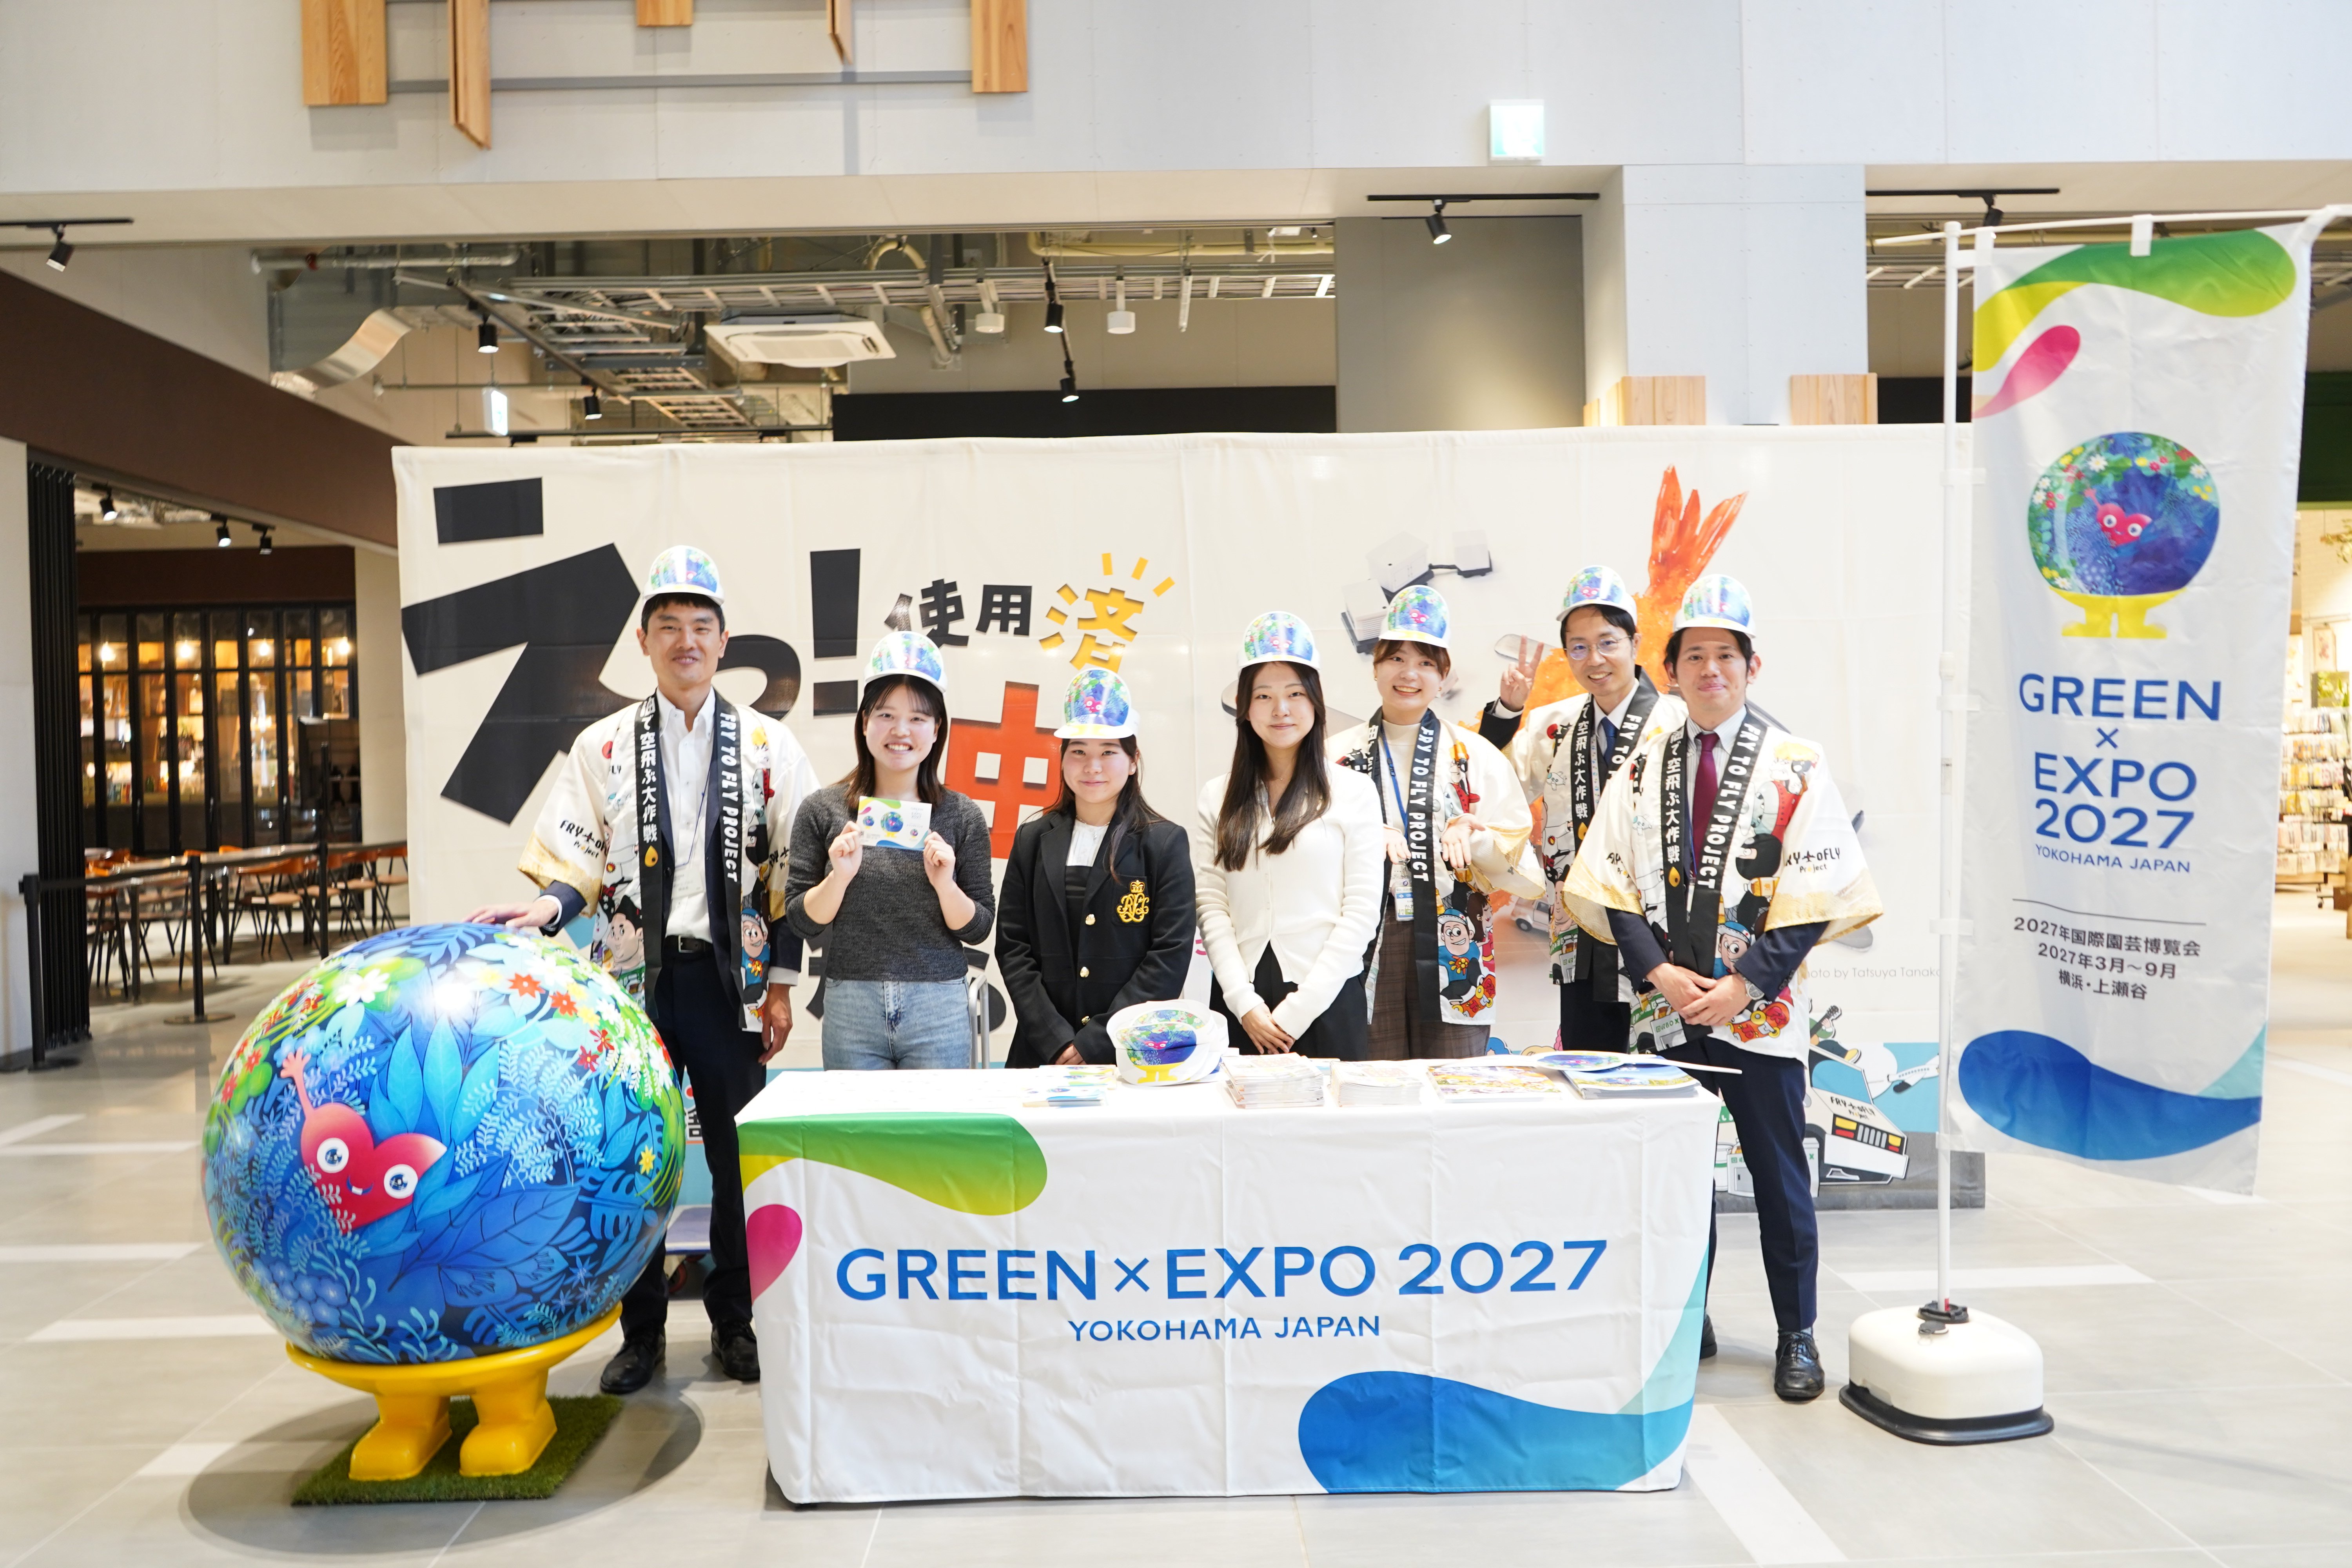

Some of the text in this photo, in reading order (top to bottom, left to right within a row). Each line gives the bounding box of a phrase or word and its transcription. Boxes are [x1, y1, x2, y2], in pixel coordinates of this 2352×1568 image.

[2020, 674, 2220, 720] GREEN
[1619, 714, 1642, 740] FRY
[1612, 746, 1630, 764] TO
[720, 713, 739, 882] FRY TO FLY PROJECT
[2035, 752, 2196, 802] EXPO
[1409, 726, 1434, 882] FRY TO FLY PROJECT
[1698, 723, 1761, 889] FRY TO FLY PROJECT
[2036, 798, 2194, 849] 2027
[2036, 844, 2190, 873] YOKOHAMA JAPAN
[2014, 917, 2200, 956] 2027年国際園芸博覧会
[1835, 968, 1849, 980] by
[1852, 967, 1896, 980] Tatsuya
[2059, 969, 2147, 1000] 横浜・上瀬谷
[837, 1249, 1096, 1301] GREEN
[1167, 1245, 1376, 1299] EXPO
[1399, 1240, 1607, 1295] 2027
[1069, 1316, 1379, 1341] YOKOHAMA JAPAN
